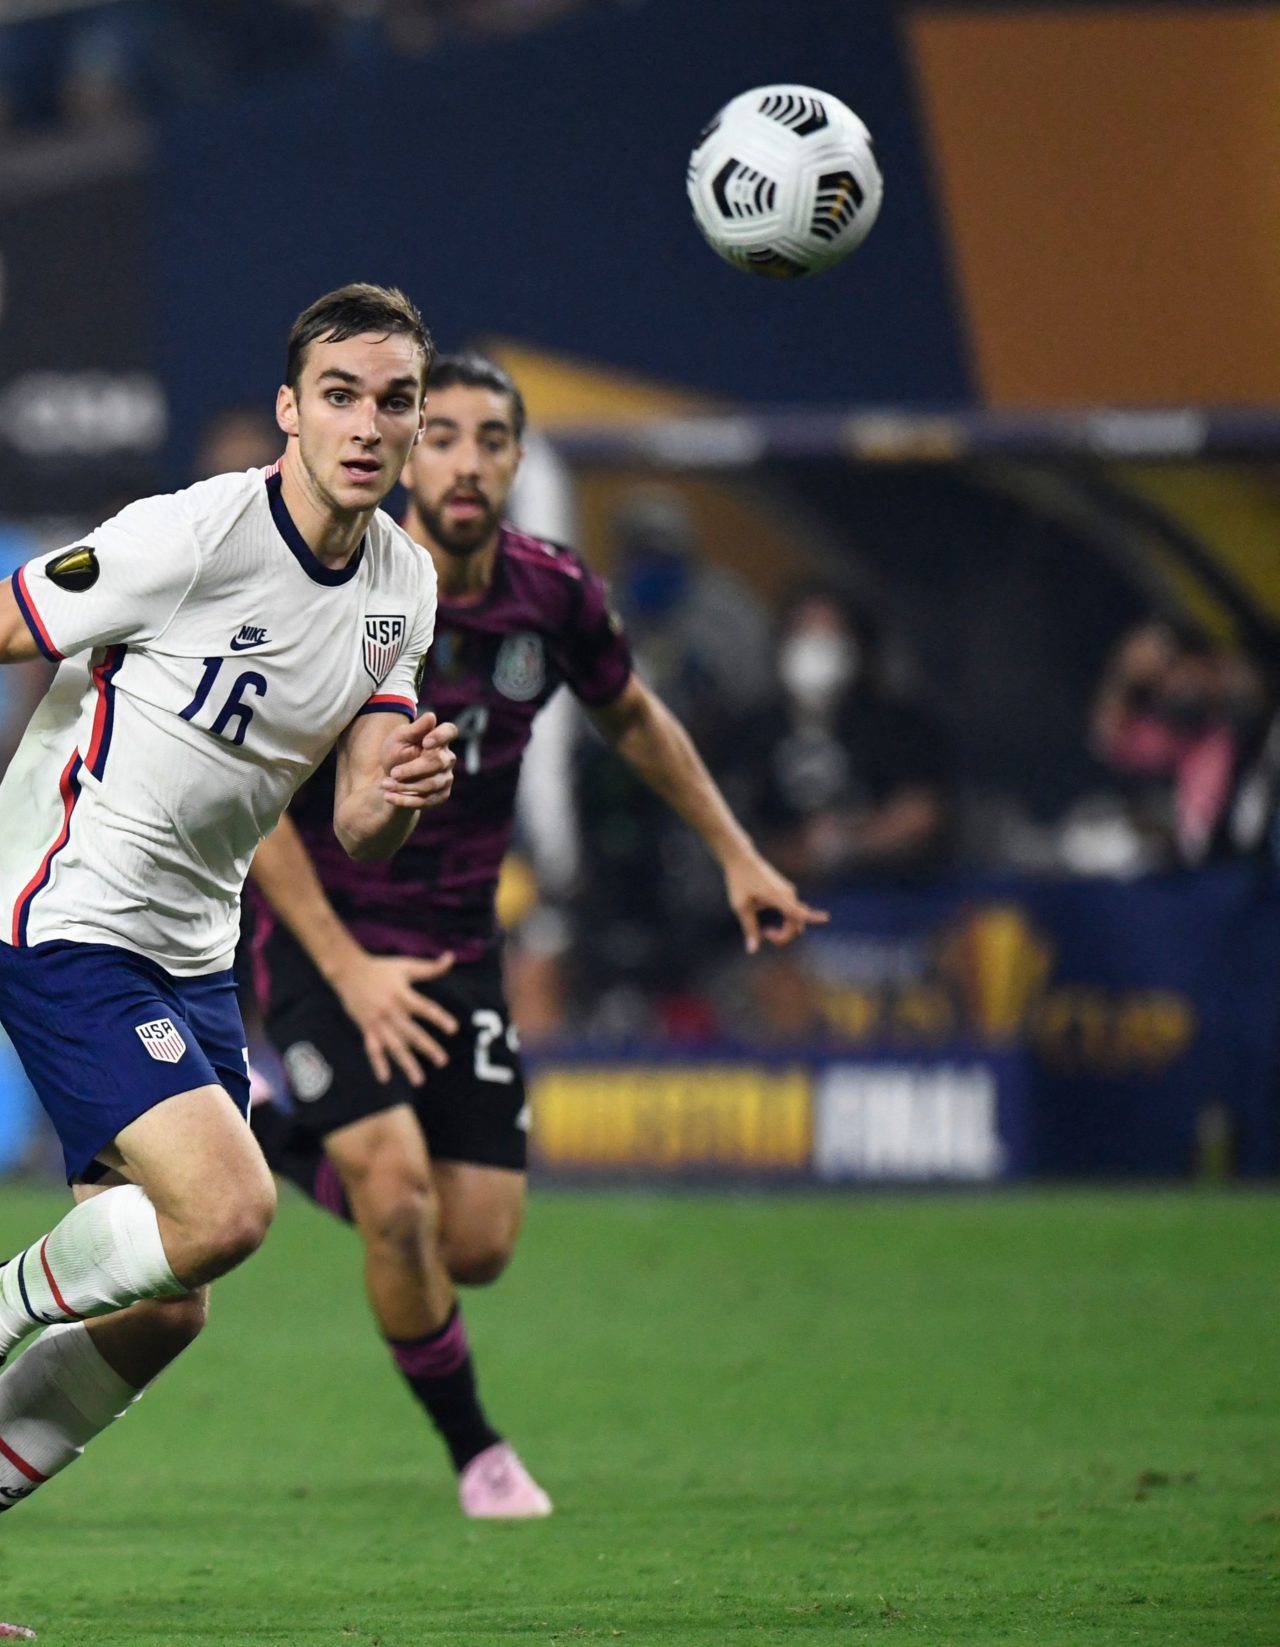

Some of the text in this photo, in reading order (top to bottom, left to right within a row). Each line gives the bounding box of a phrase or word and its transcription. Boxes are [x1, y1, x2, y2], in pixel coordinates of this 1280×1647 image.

[237, 625, 268, 642] NIKE
[366, 620, 402, 646] USA
[178, 656, 268, 746] 16
[140, 1021, 173, 1040] USA
